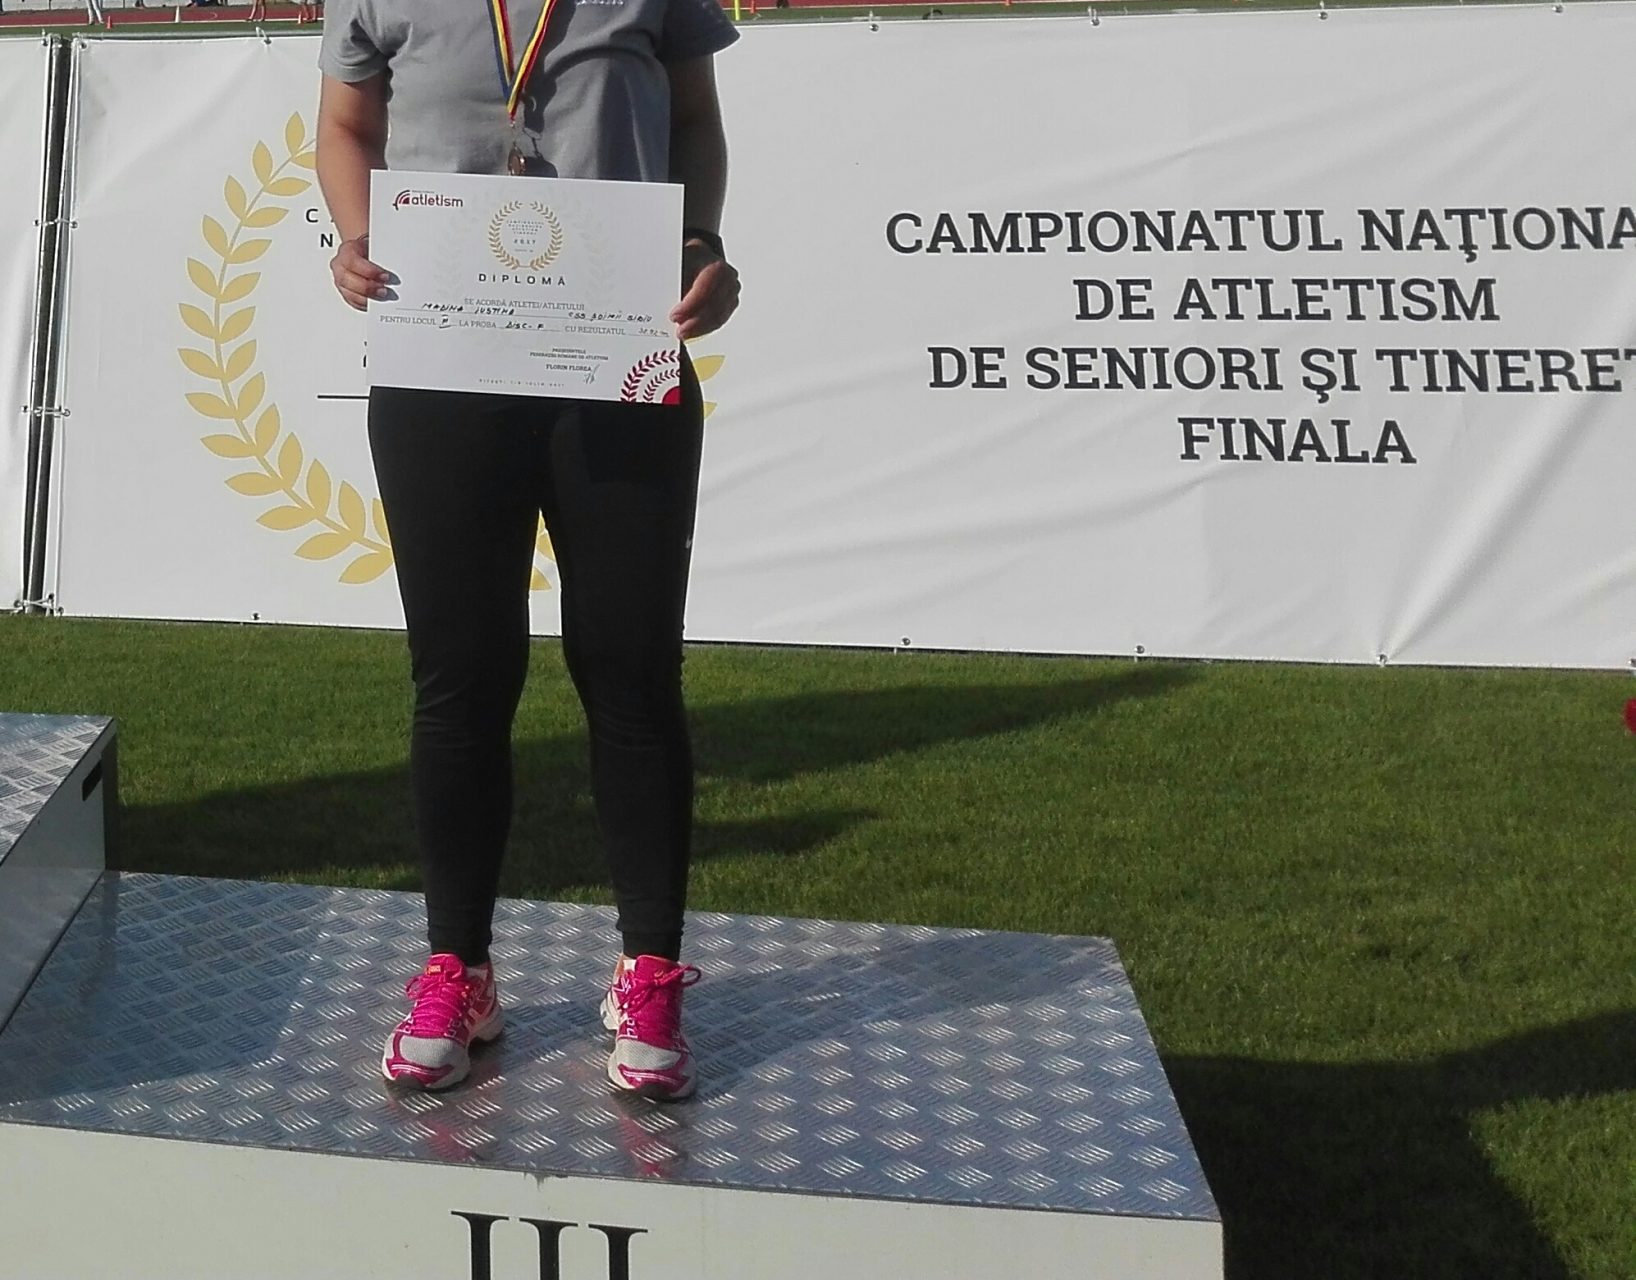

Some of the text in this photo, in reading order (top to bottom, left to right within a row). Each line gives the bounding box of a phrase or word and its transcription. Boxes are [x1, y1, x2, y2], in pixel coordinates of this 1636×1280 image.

[411, 194, 463, 207] atletism
[885, 209, 1343, 254] CAMPIONATUL
[1073, 277, 1501, 322] DE ATLETISM
[380, 315, 437, 326] PENTRU LOCUL
[459, 320, 496, 329] LA PROBA
[564, 325, 626, 336] CU REZULTATUL
[928, 346, 1008, 390] DE
[1025, 346, 1283, 391] SENIORI
[1376, 347, 1636, 393] TINERE
[1178, 417, 1417, 464] FINALA
